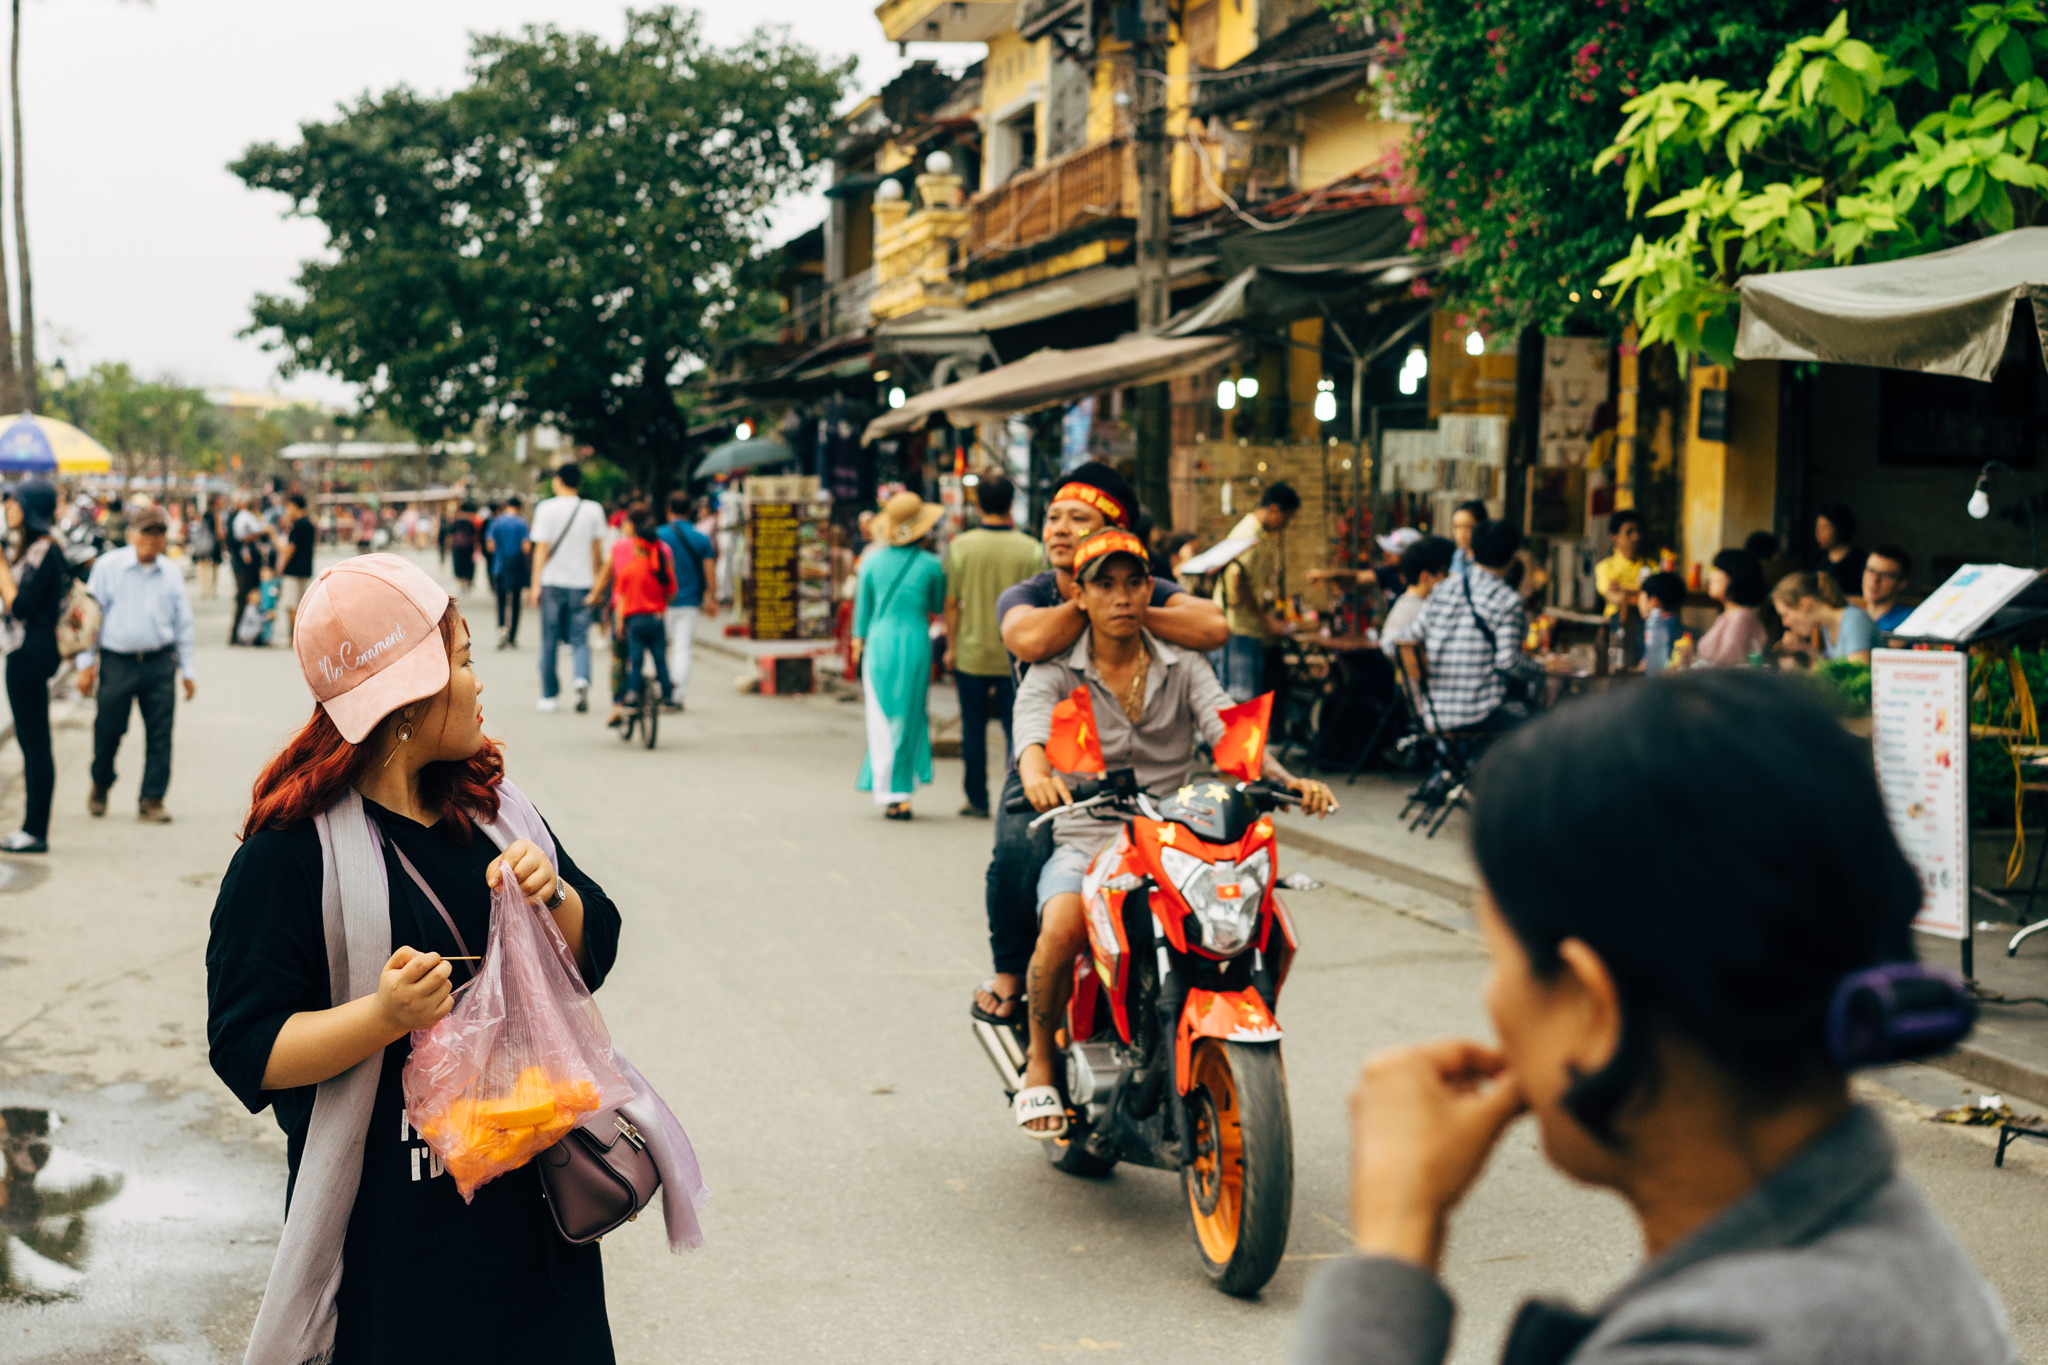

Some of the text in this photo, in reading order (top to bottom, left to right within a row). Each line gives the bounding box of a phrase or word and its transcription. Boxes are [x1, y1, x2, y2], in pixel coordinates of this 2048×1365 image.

[318, 622, 406, 685] No Comment
[1020, 1094, 1056, 1112] FILA
